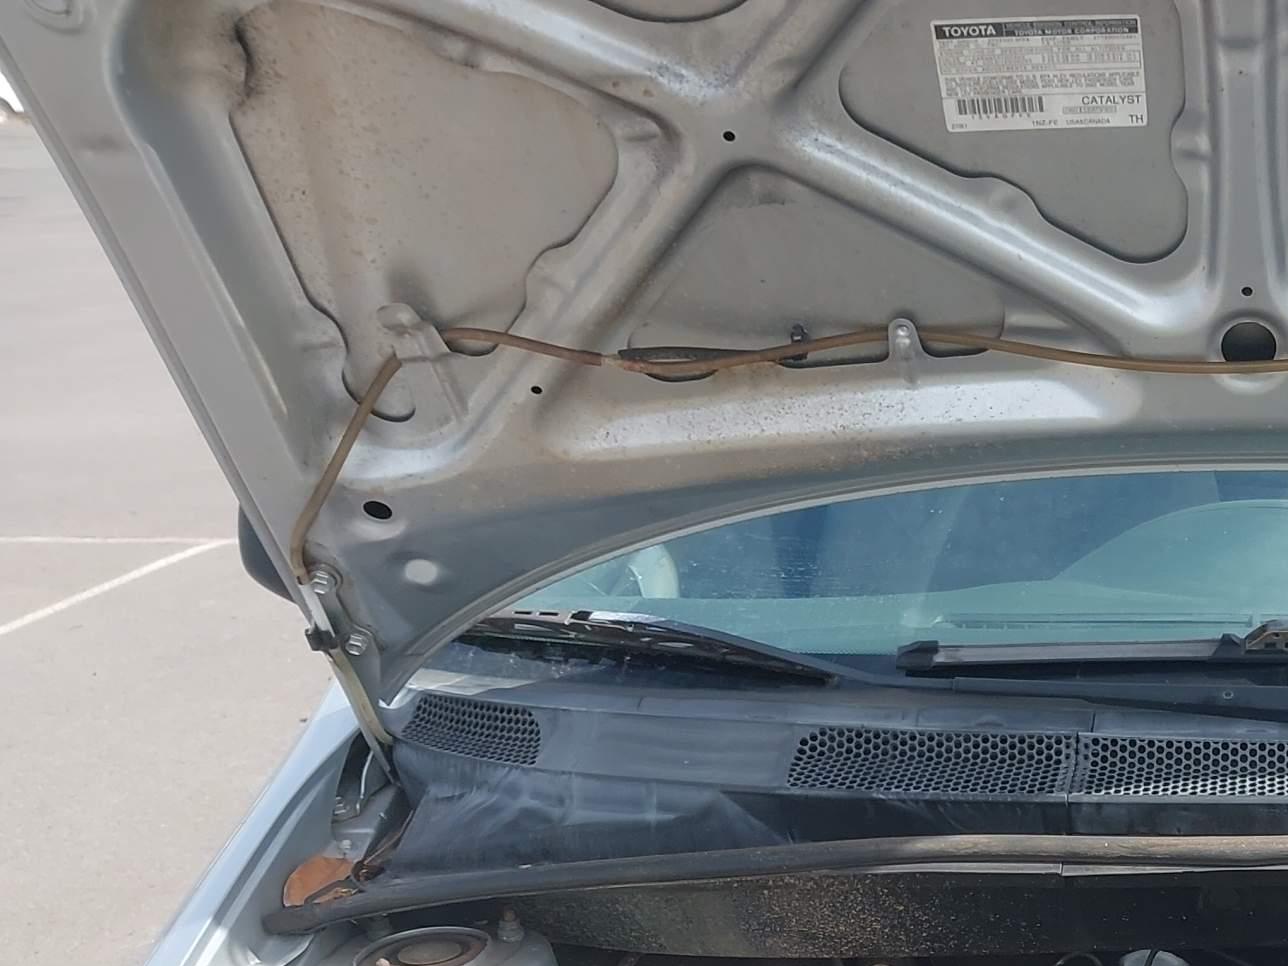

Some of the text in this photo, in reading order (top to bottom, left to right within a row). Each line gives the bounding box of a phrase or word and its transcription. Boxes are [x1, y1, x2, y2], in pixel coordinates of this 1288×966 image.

[942, 25, 997, 37] TOYOTA
[1081, 95, 1143, 105] CATALYST
[1128, 114, 1144, 124] TH
